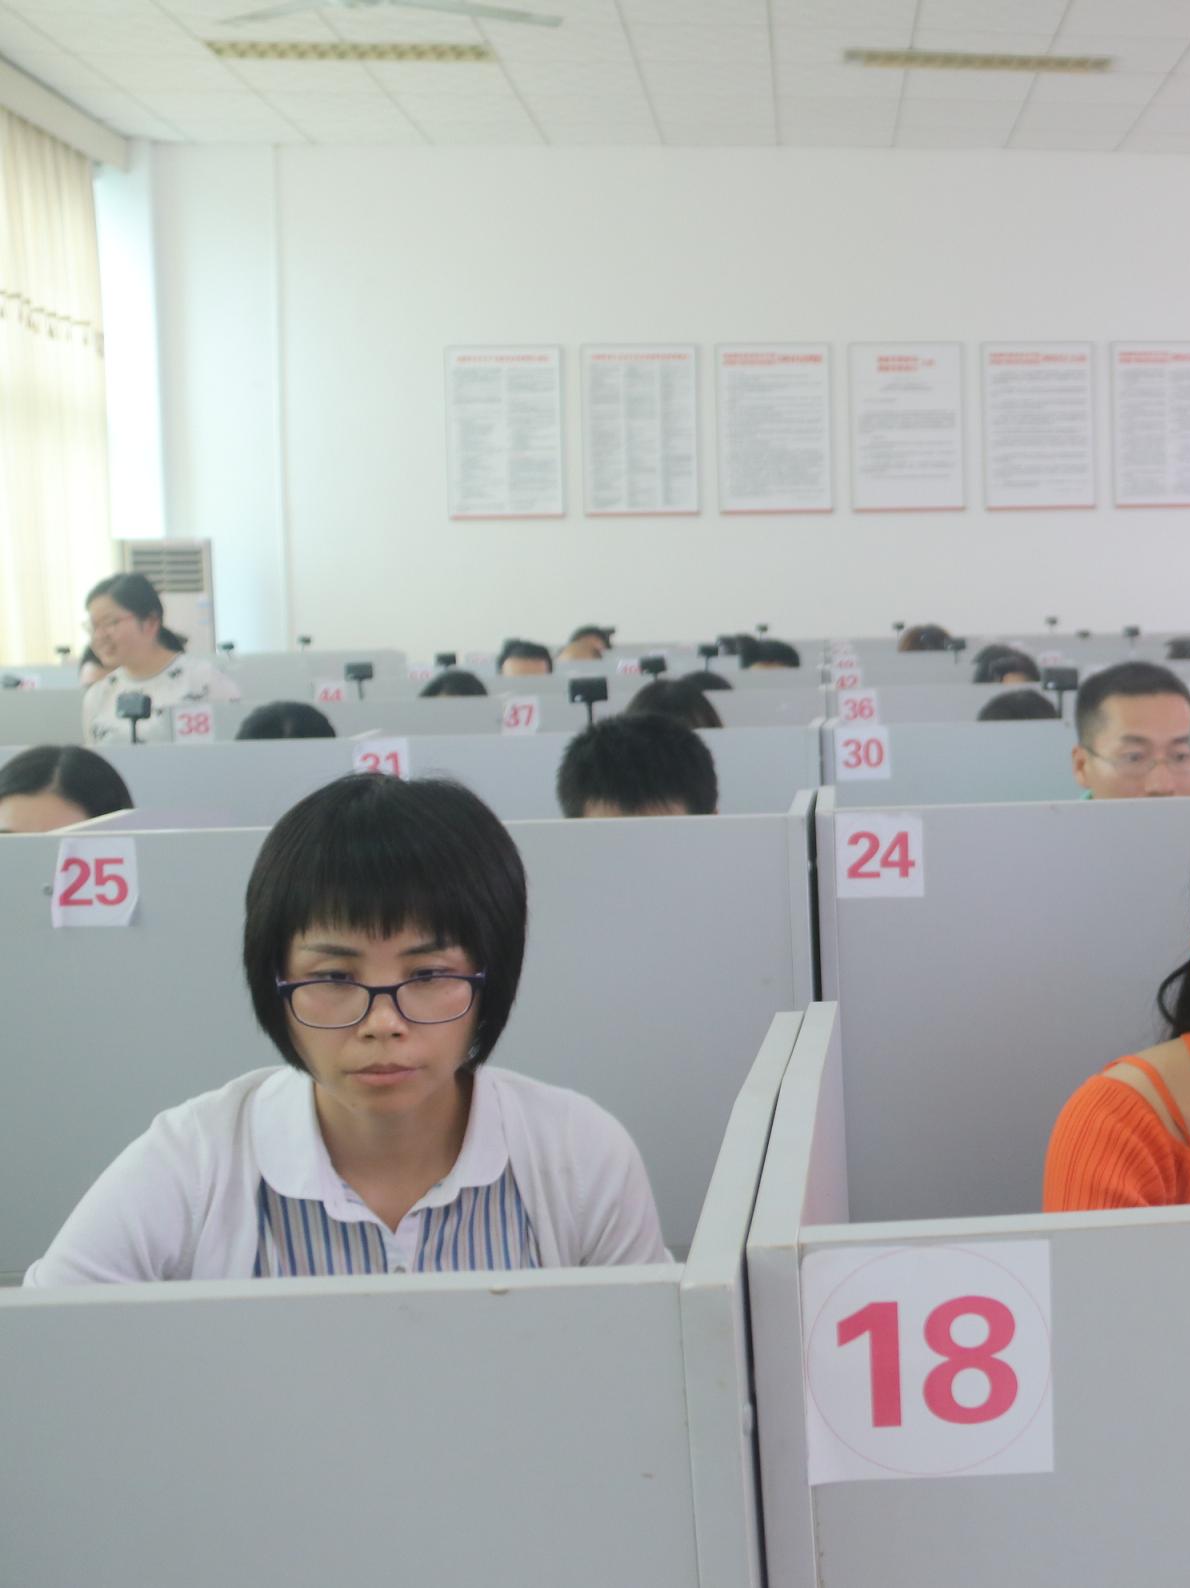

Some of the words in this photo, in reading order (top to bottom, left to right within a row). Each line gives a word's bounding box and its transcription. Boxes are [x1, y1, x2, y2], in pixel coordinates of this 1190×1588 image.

[177, 713, 211, 735] 38
[505, 704, 535, 728] 37
[843, 698, 875, 720] 36
[841, 738, 885, 769] 30
[846, 831, 915, 880] 24
[58, 857, 129, 907] 25
[836, 1295, 1019, 1428] 18
